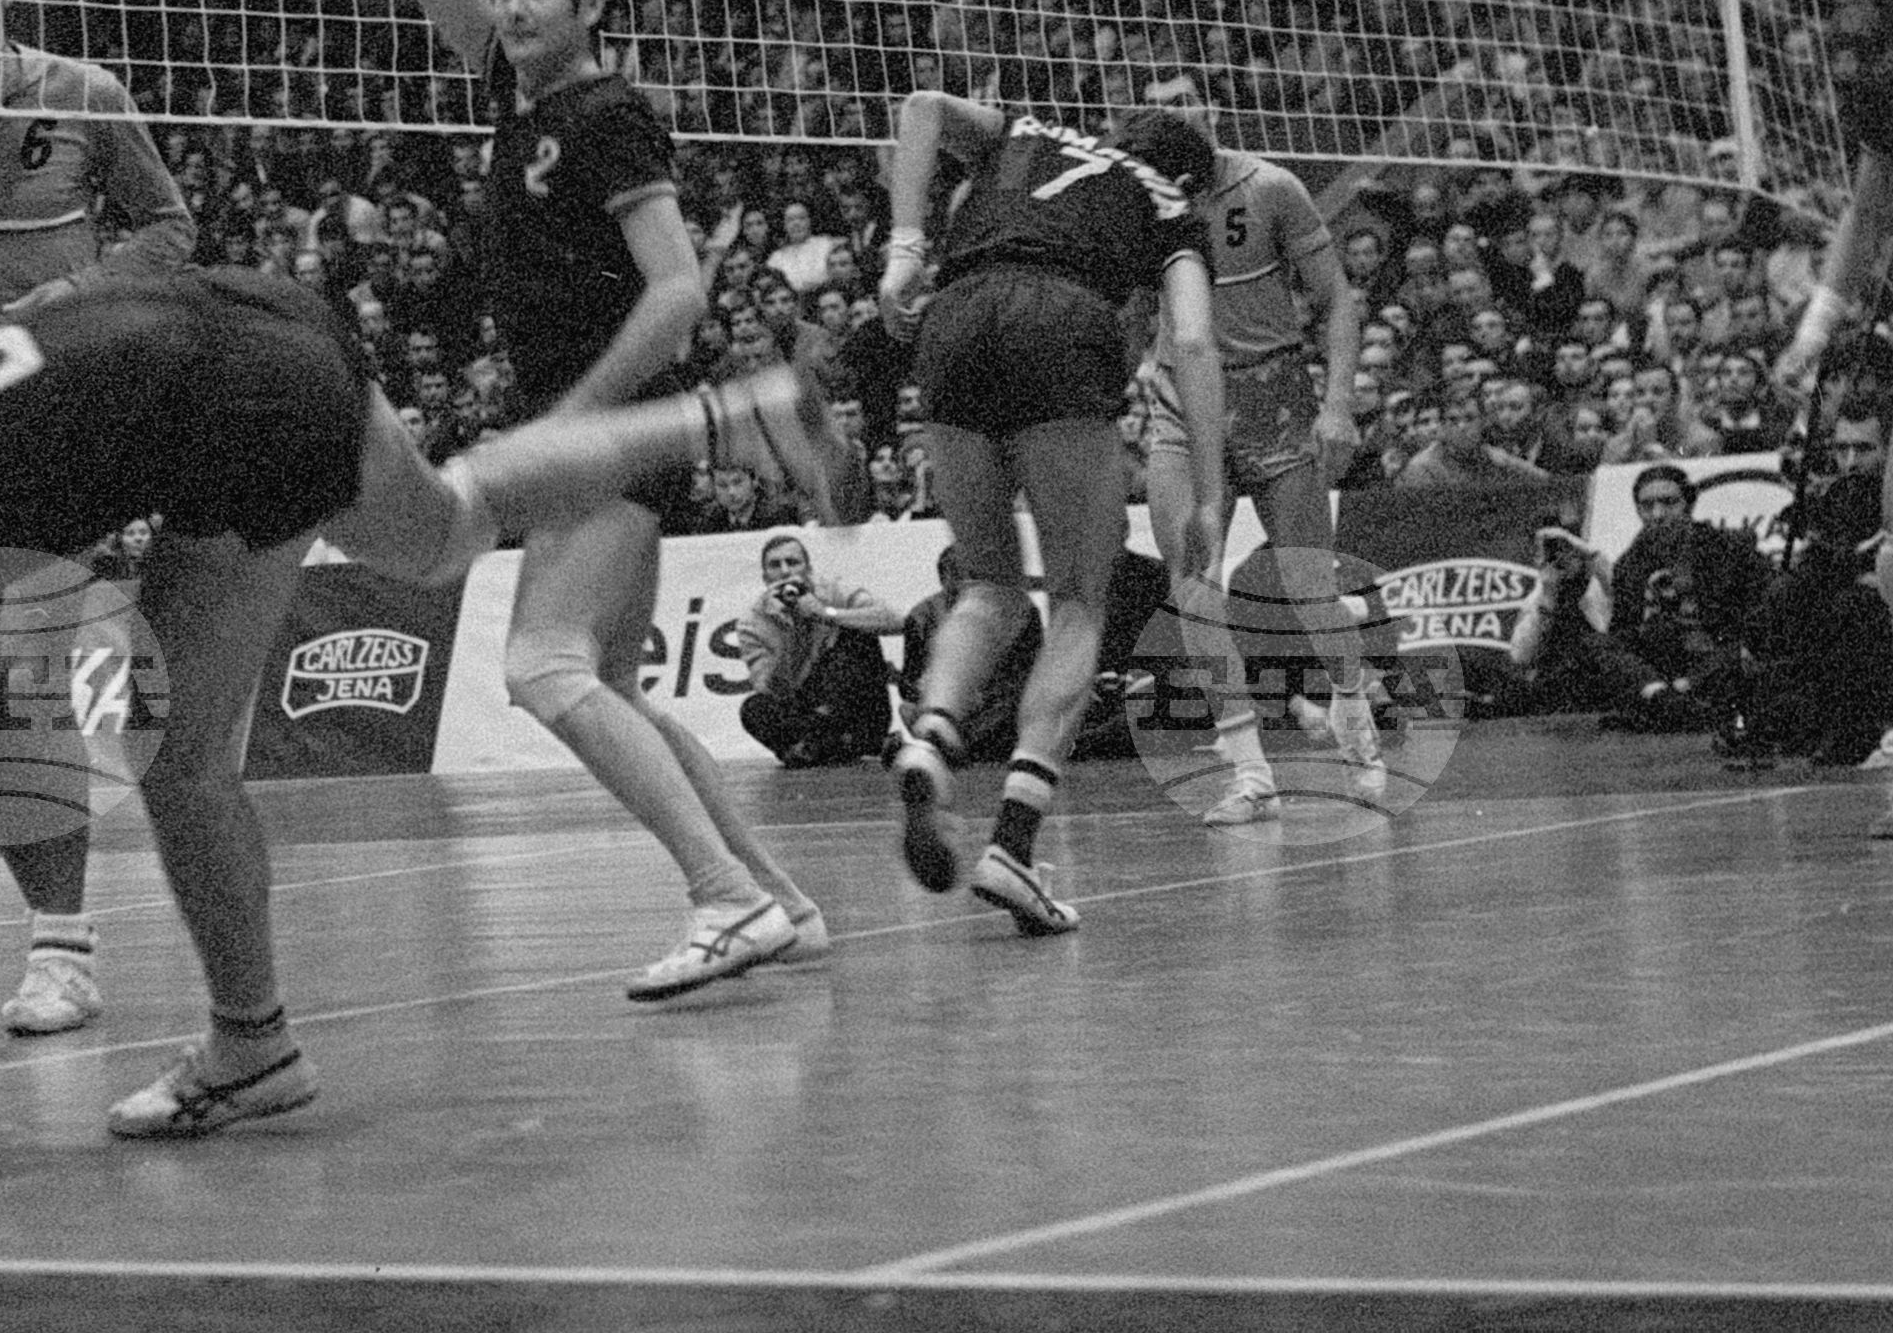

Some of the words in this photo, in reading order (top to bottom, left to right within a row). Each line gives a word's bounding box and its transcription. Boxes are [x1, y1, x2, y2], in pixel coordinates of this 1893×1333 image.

[19, 118, 58, 170] 6
[525, 136, 560, 196] 2
[1030, 145, 1115, 201] 7
[1226, 207, 1247, 248] 5
[1401, 612, 1502, 640] JENA
[315, 676, 393, 701] JENA
